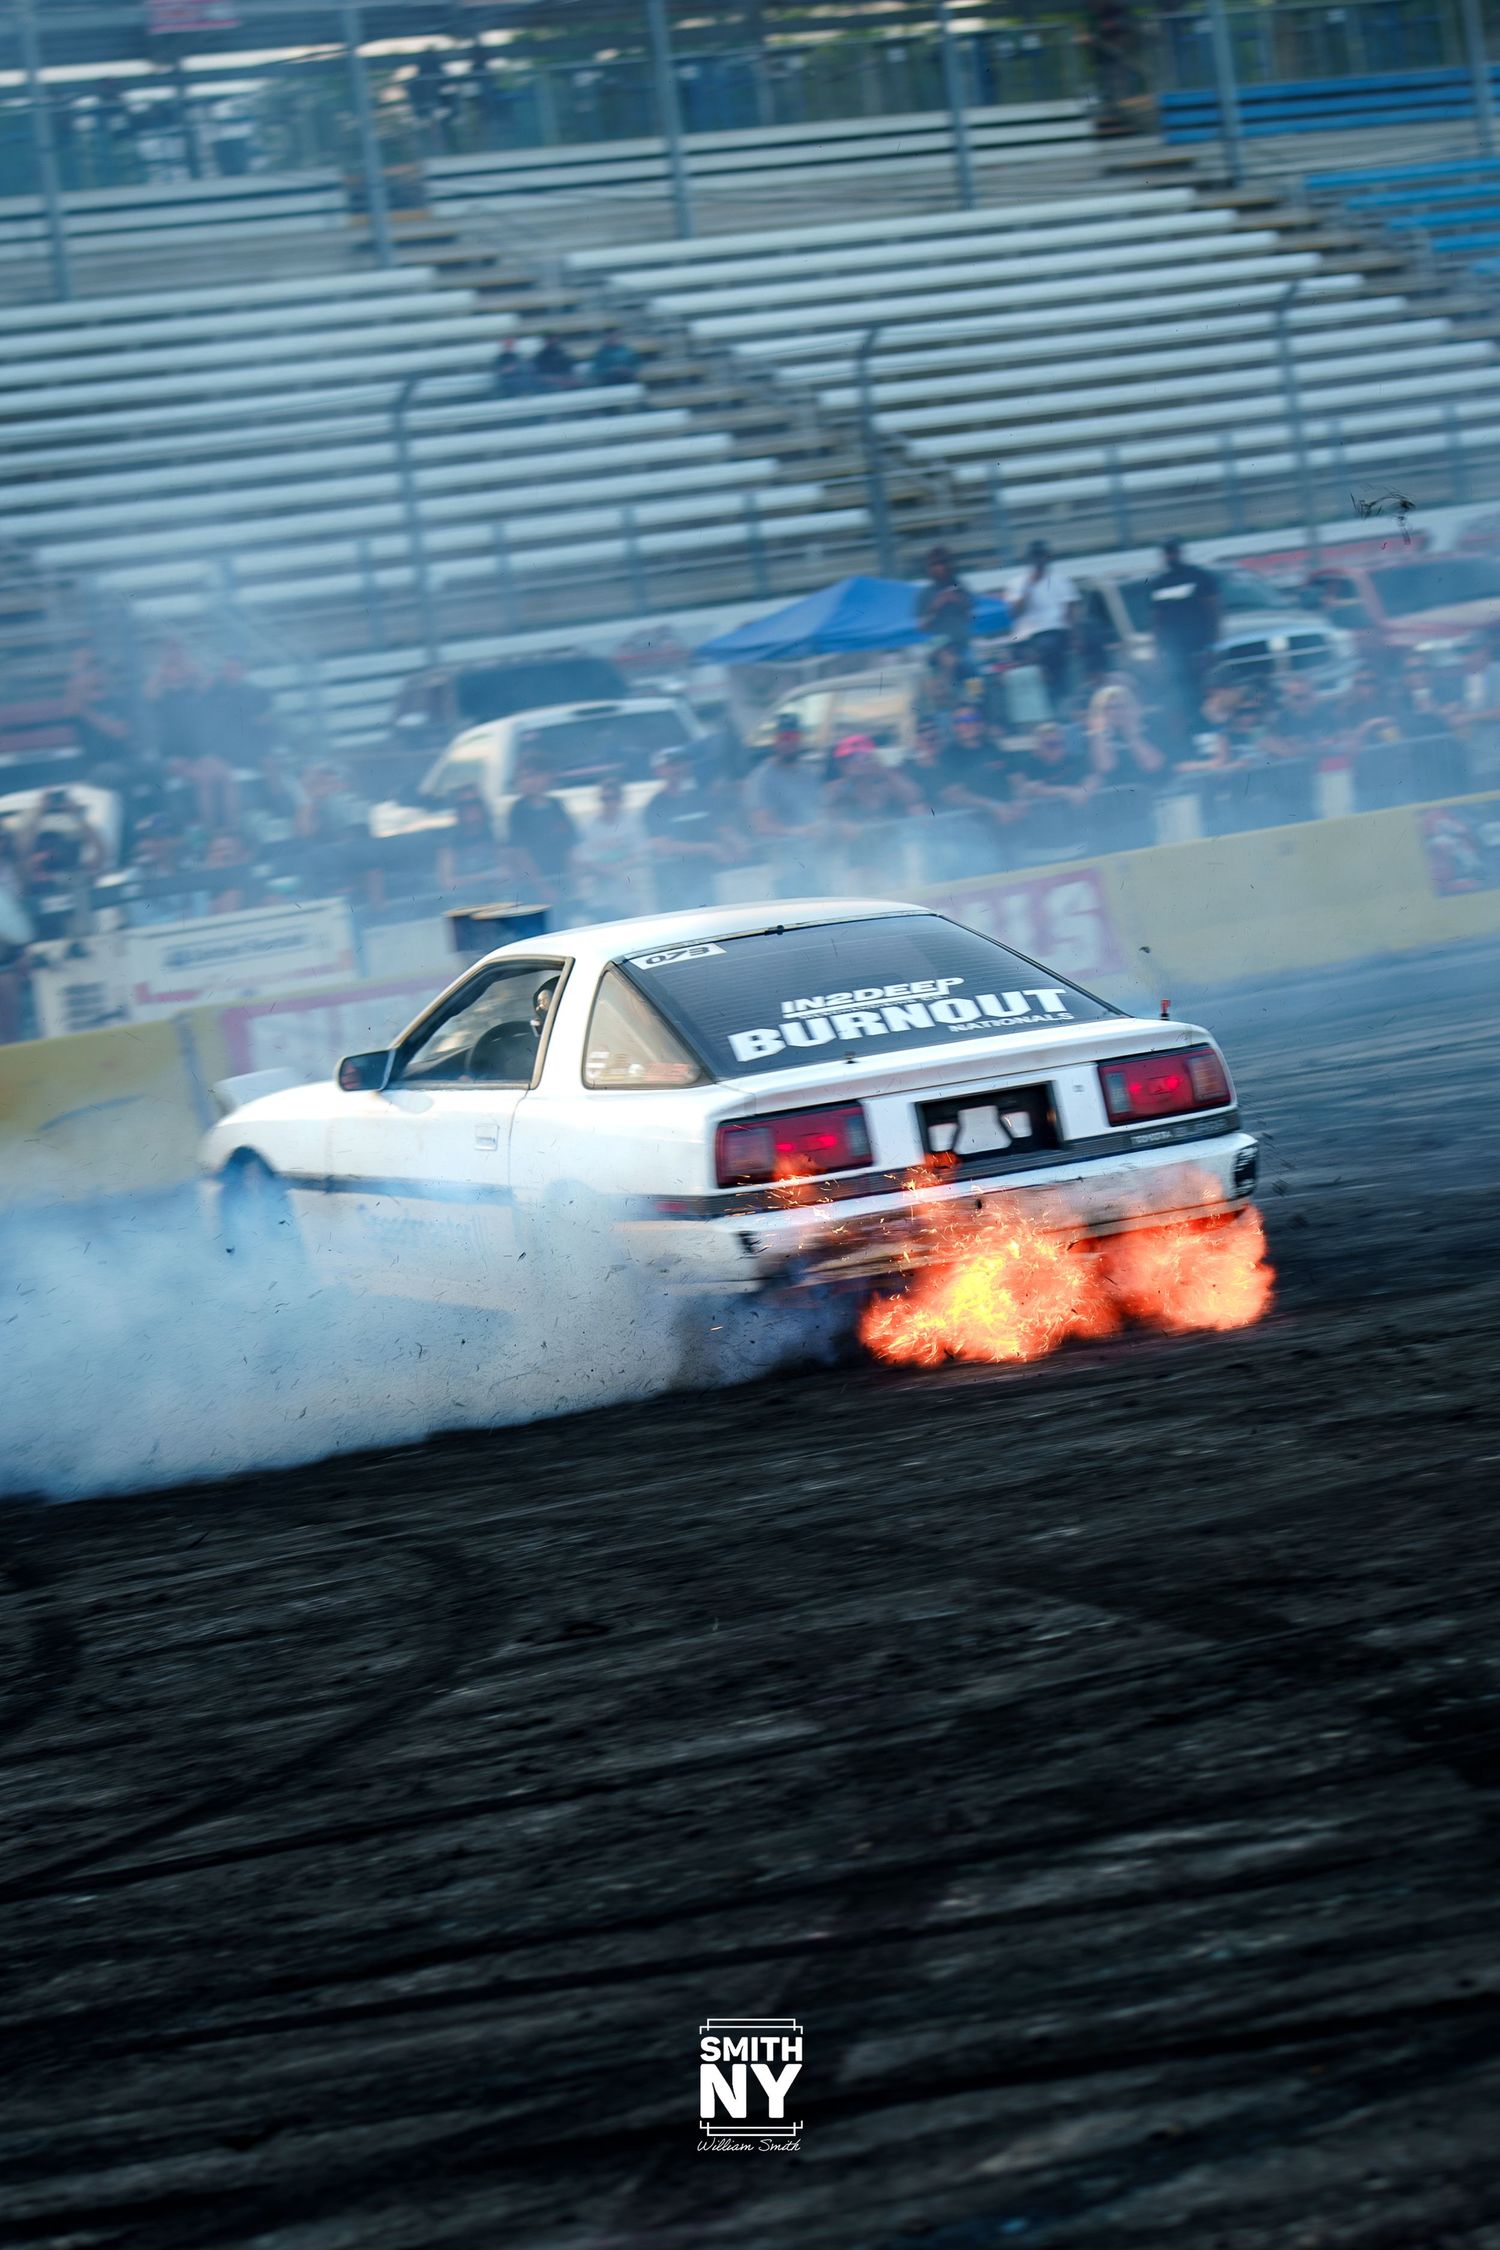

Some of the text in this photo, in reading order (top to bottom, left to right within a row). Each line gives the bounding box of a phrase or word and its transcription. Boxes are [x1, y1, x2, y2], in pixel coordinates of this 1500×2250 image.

[645, 945, 710, 965] 073
[780, 976, 966, 1014] IN2DEEP
[727, 988, 1068, 1063] BURNOUT
[949, 1012, 1075, 1033] NATIONALS
